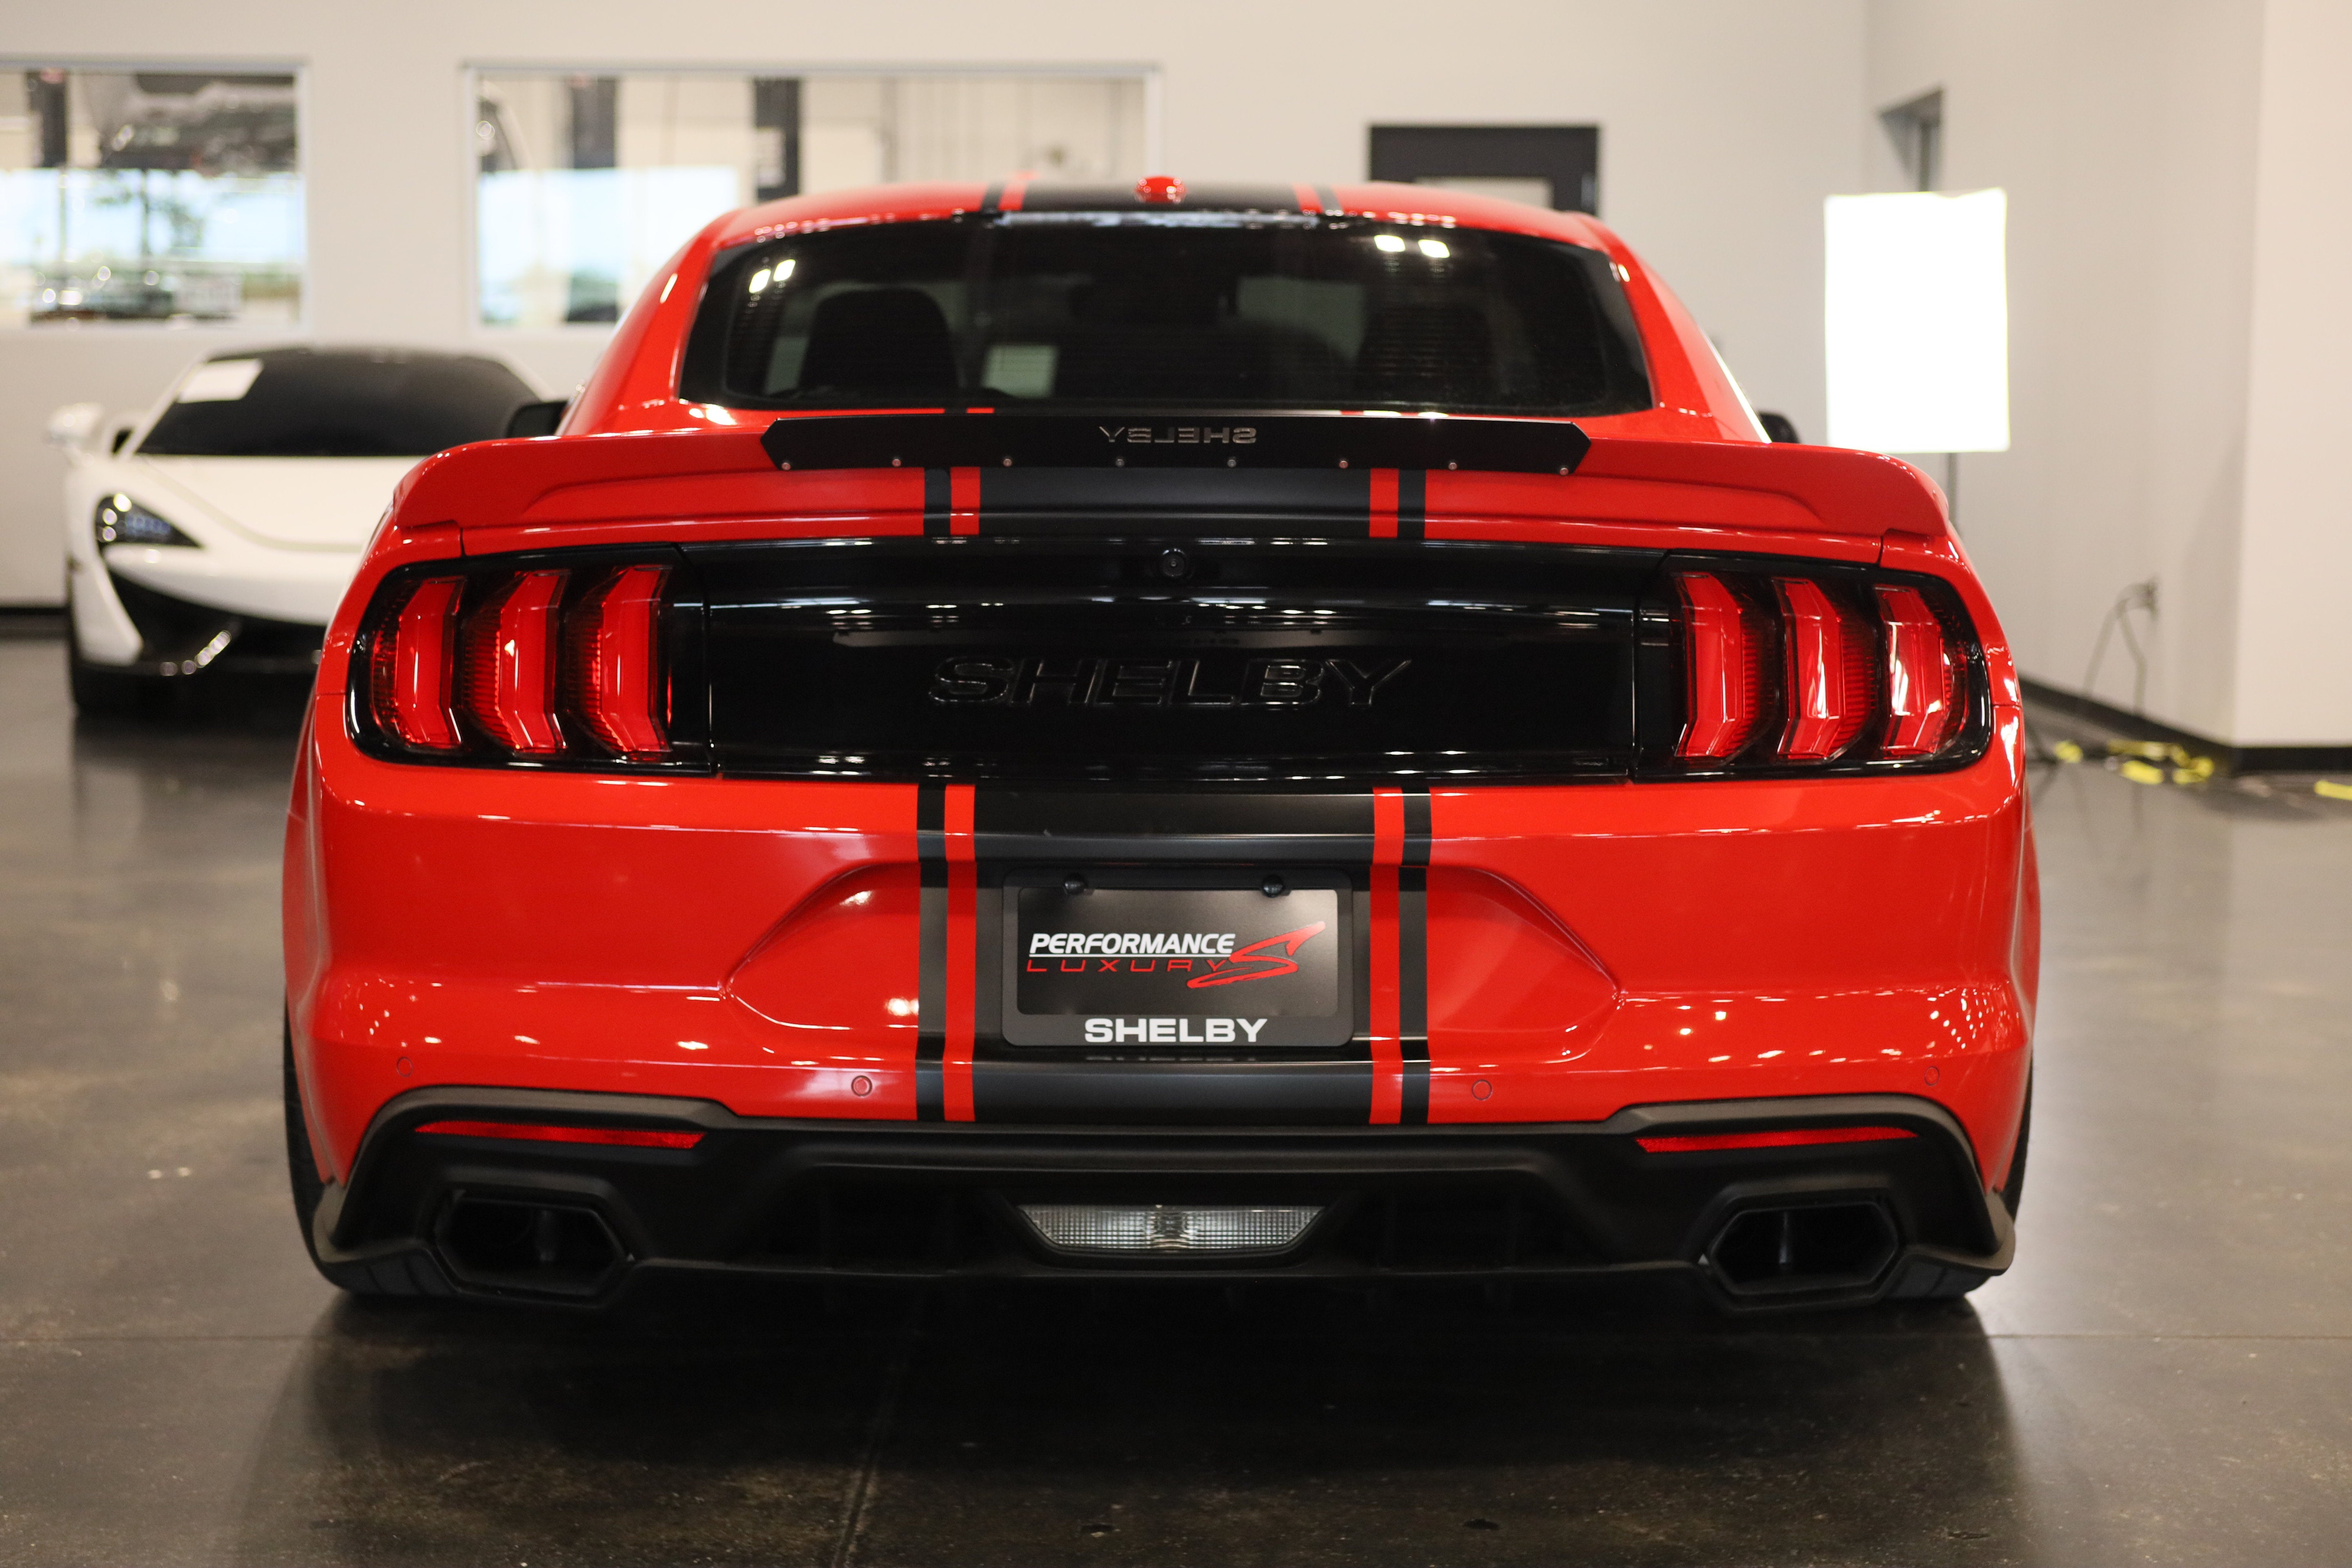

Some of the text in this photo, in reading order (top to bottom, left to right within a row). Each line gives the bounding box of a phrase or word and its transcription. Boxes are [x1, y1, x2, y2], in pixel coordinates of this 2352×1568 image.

[928, 656, 1412, 706] SHELBY
[1029, 933, 1236, 954] PERFORMANCE
[1026, 959, 1226, 972] LUXURY
[1084, 1018, 1268, 1042] SHELBY
